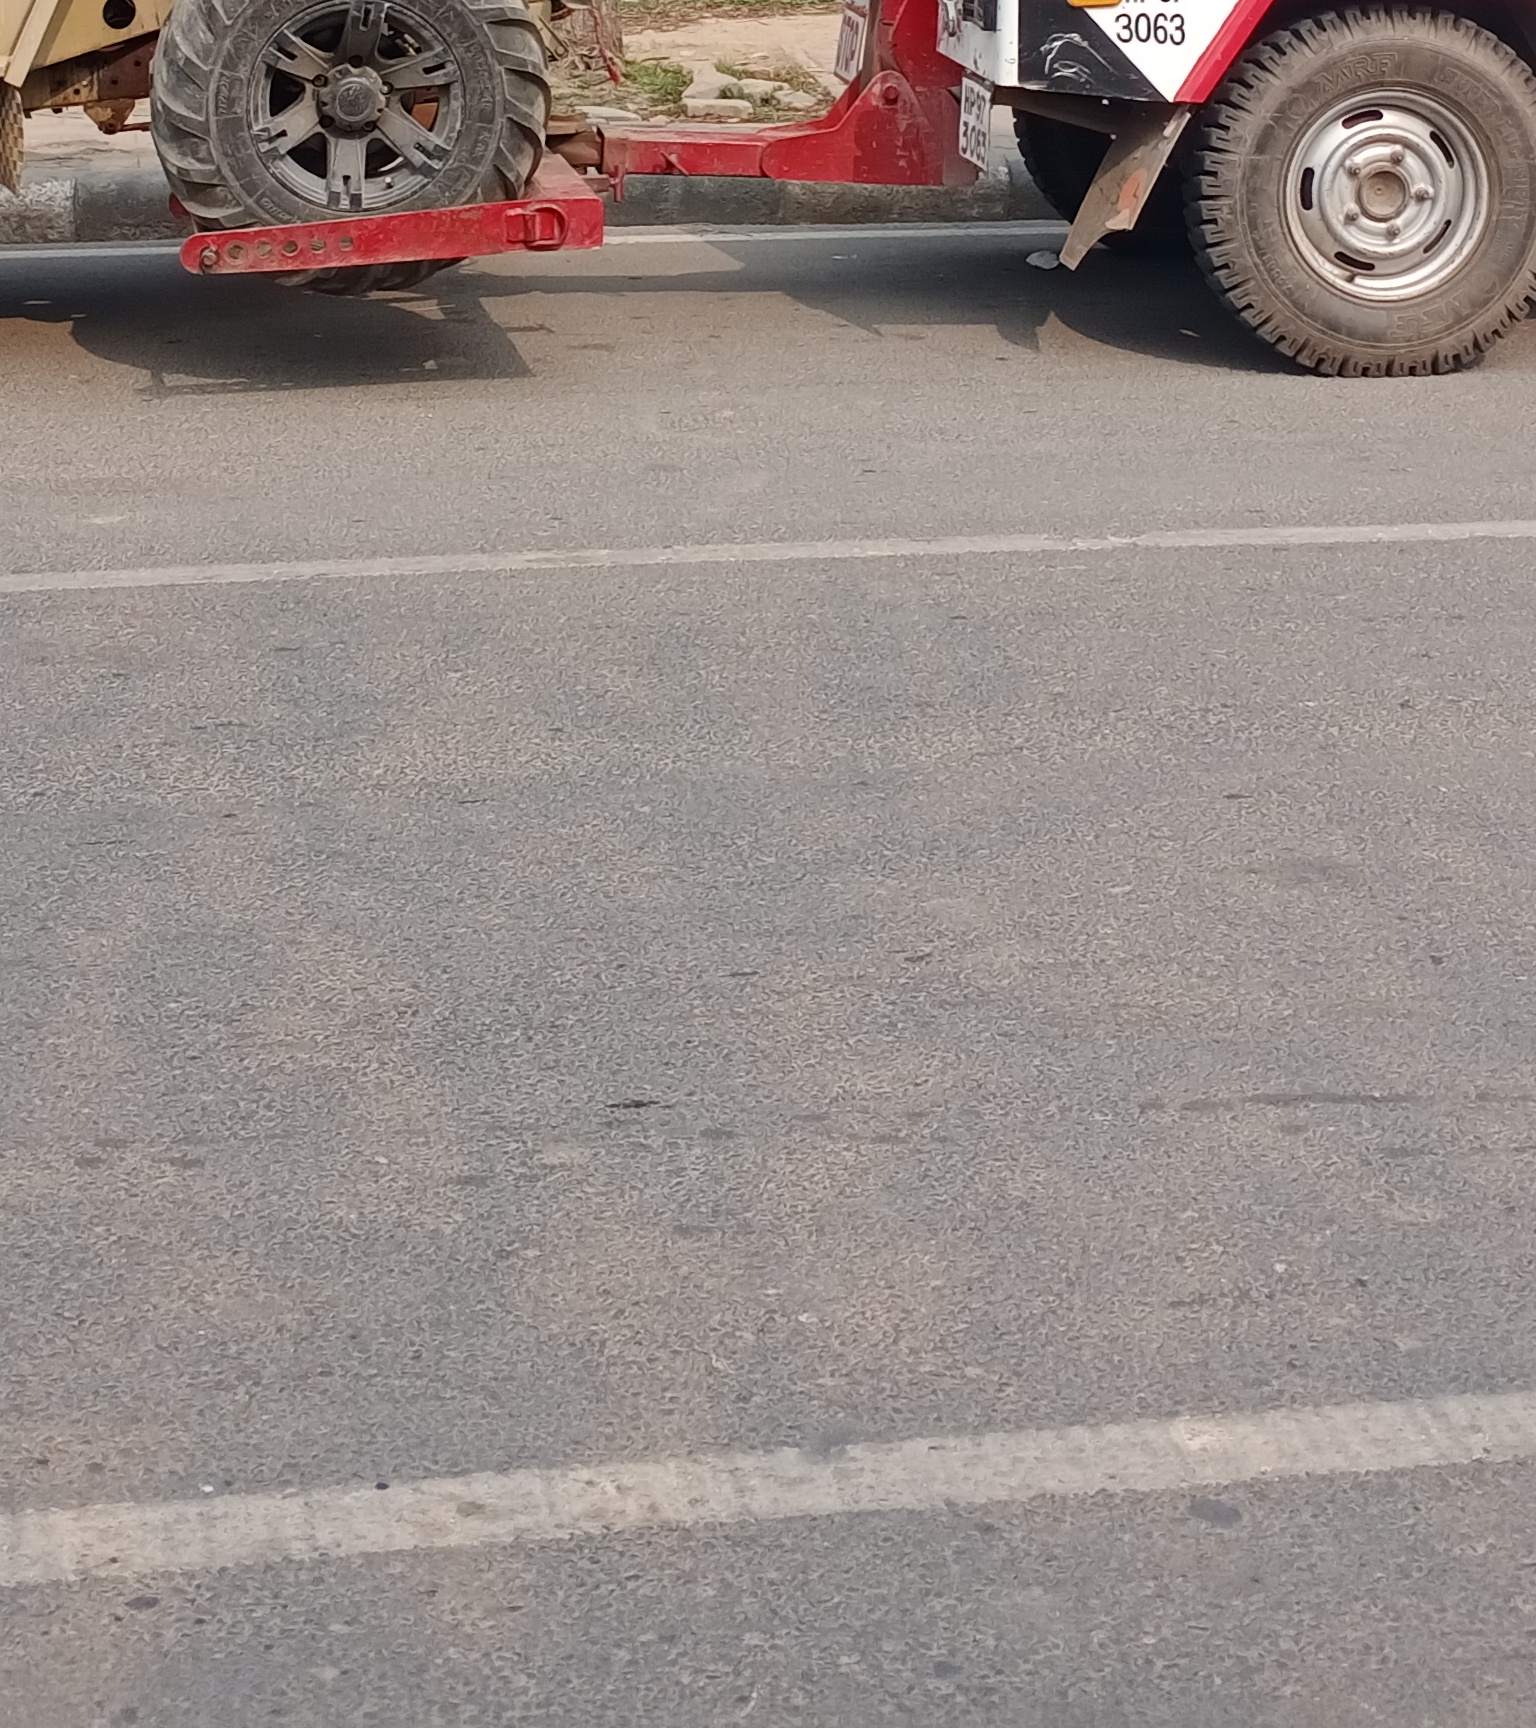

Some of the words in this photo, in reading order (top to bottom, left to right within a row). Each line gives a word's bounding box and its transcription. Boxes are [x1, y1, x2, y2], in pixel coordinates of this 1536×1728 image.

[1114, 12, 1186, 46] 3063
[1314, 52, 1398, 93] MRF
[961, 120, 987, 166] 3063
